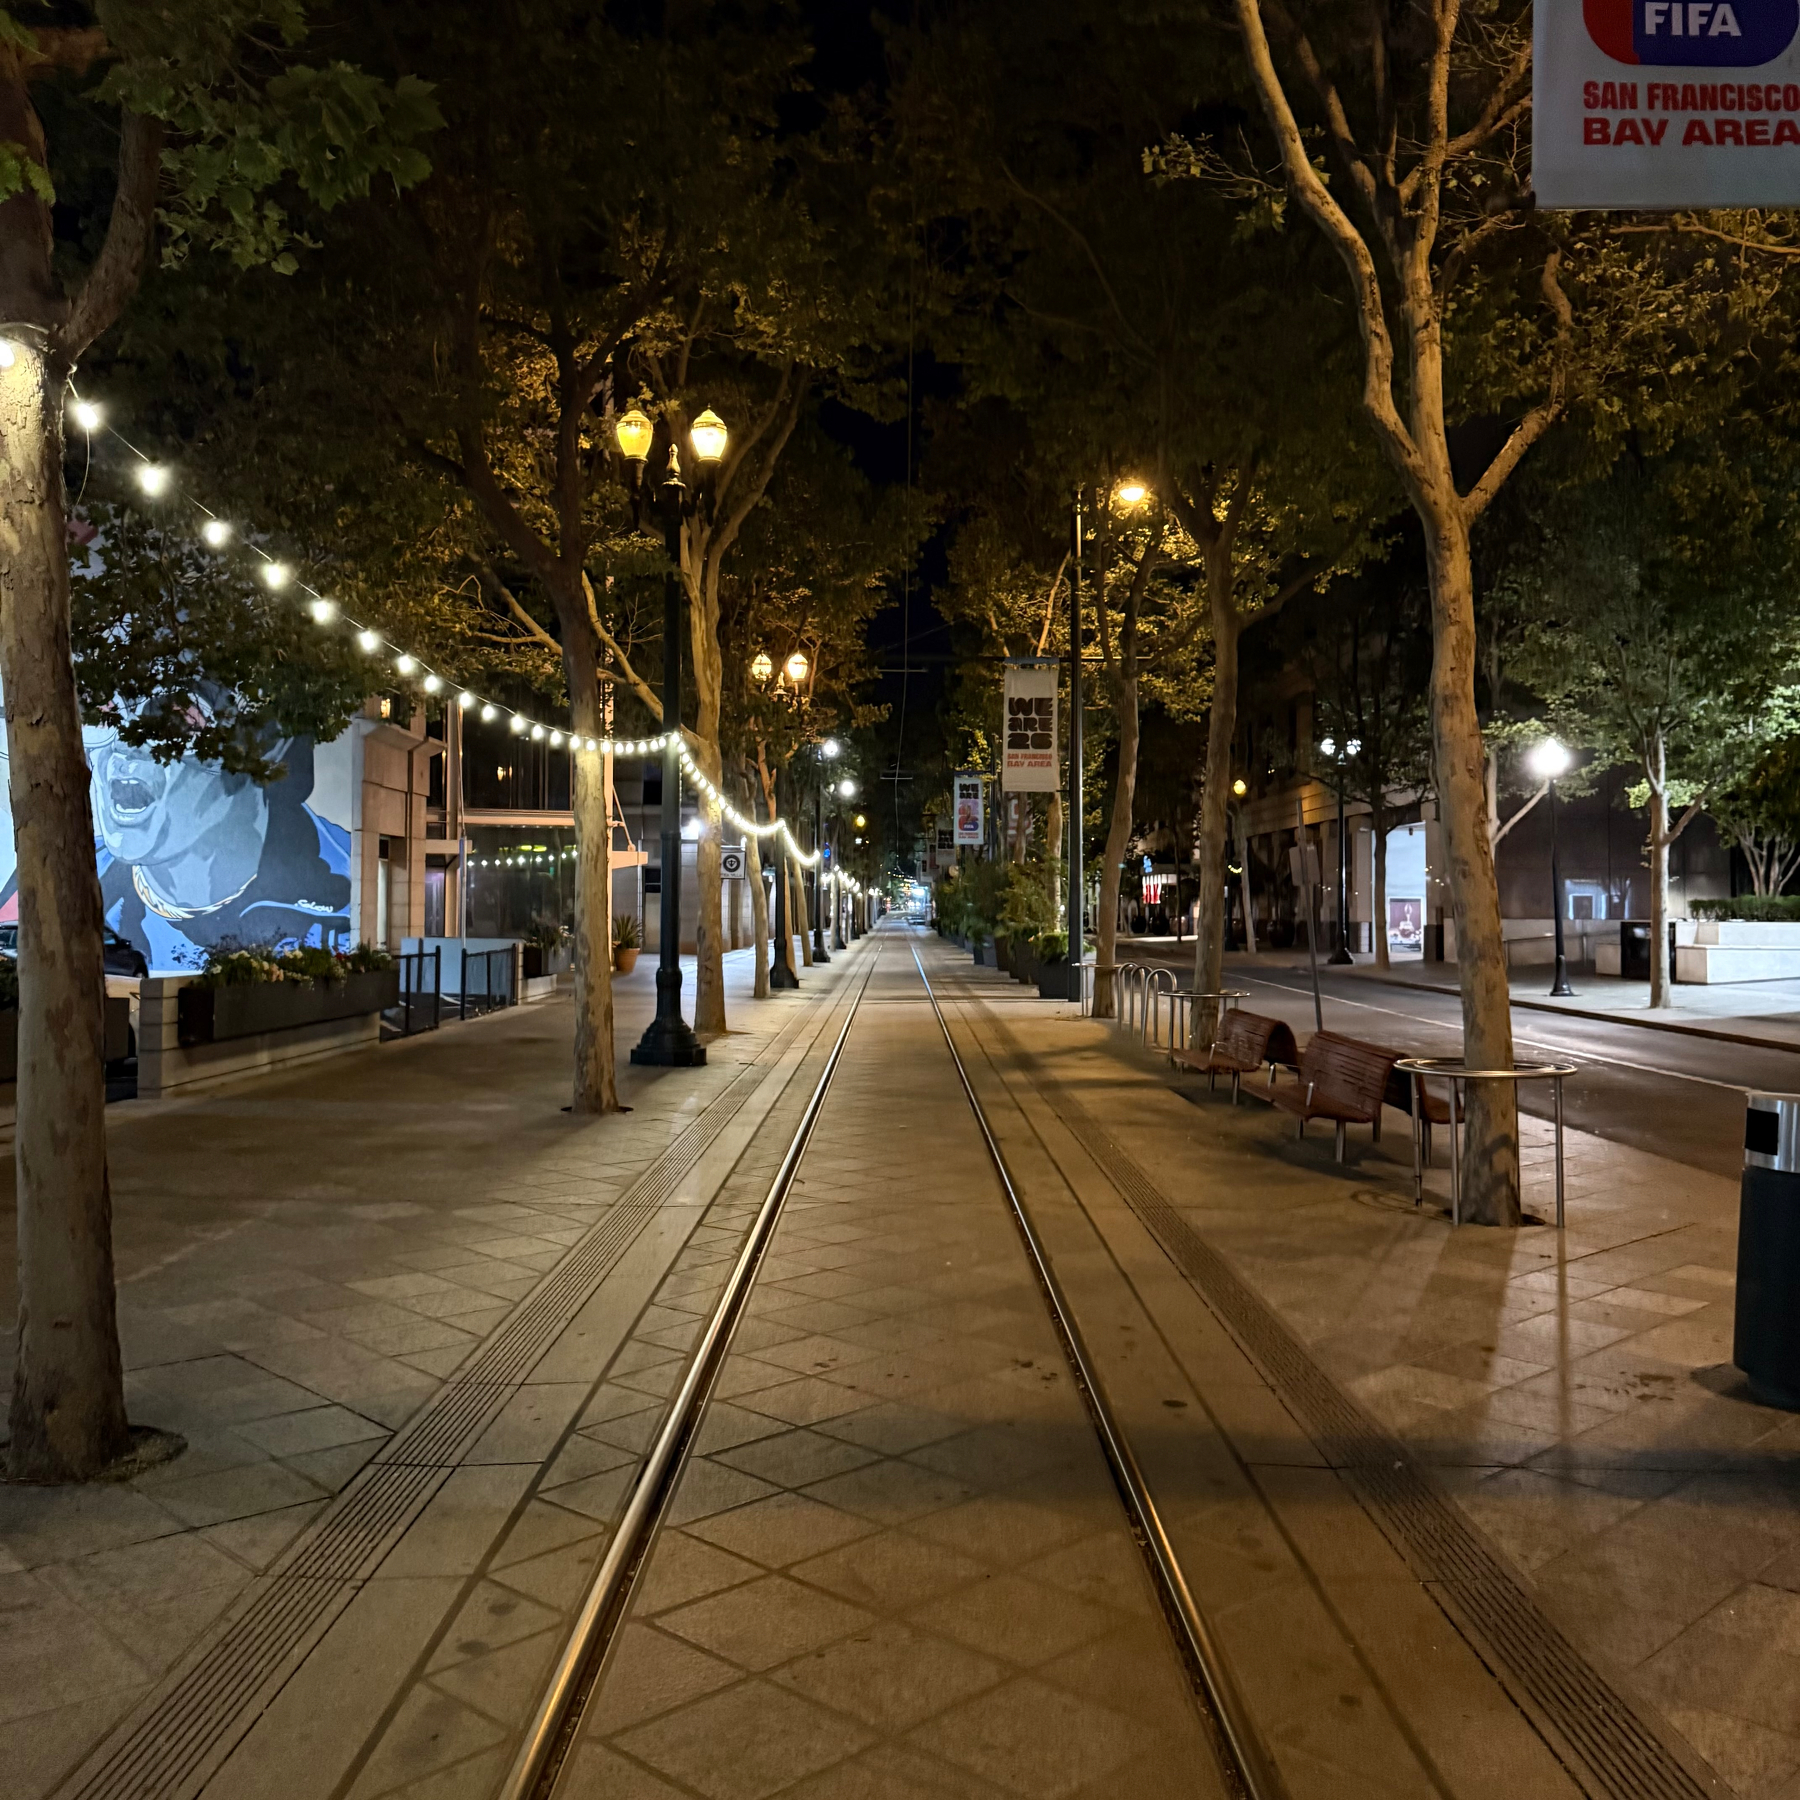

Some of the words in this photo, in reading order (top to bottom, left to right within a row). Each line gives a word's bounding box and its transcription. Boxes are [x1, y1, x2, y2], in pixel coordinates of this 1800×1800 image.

[1645, 2, 1742, 37] FIFA
[1583, 80, 1638, 110] SAN
[1647, 82, 1800, 112] FRANCISCO
[1583, 117, 1669, 146] BAY
[1682, 118, 1800, 146] AREA
[1008, 697, 1053, 717] WE
[1007, 733, 1052, 750] 26
